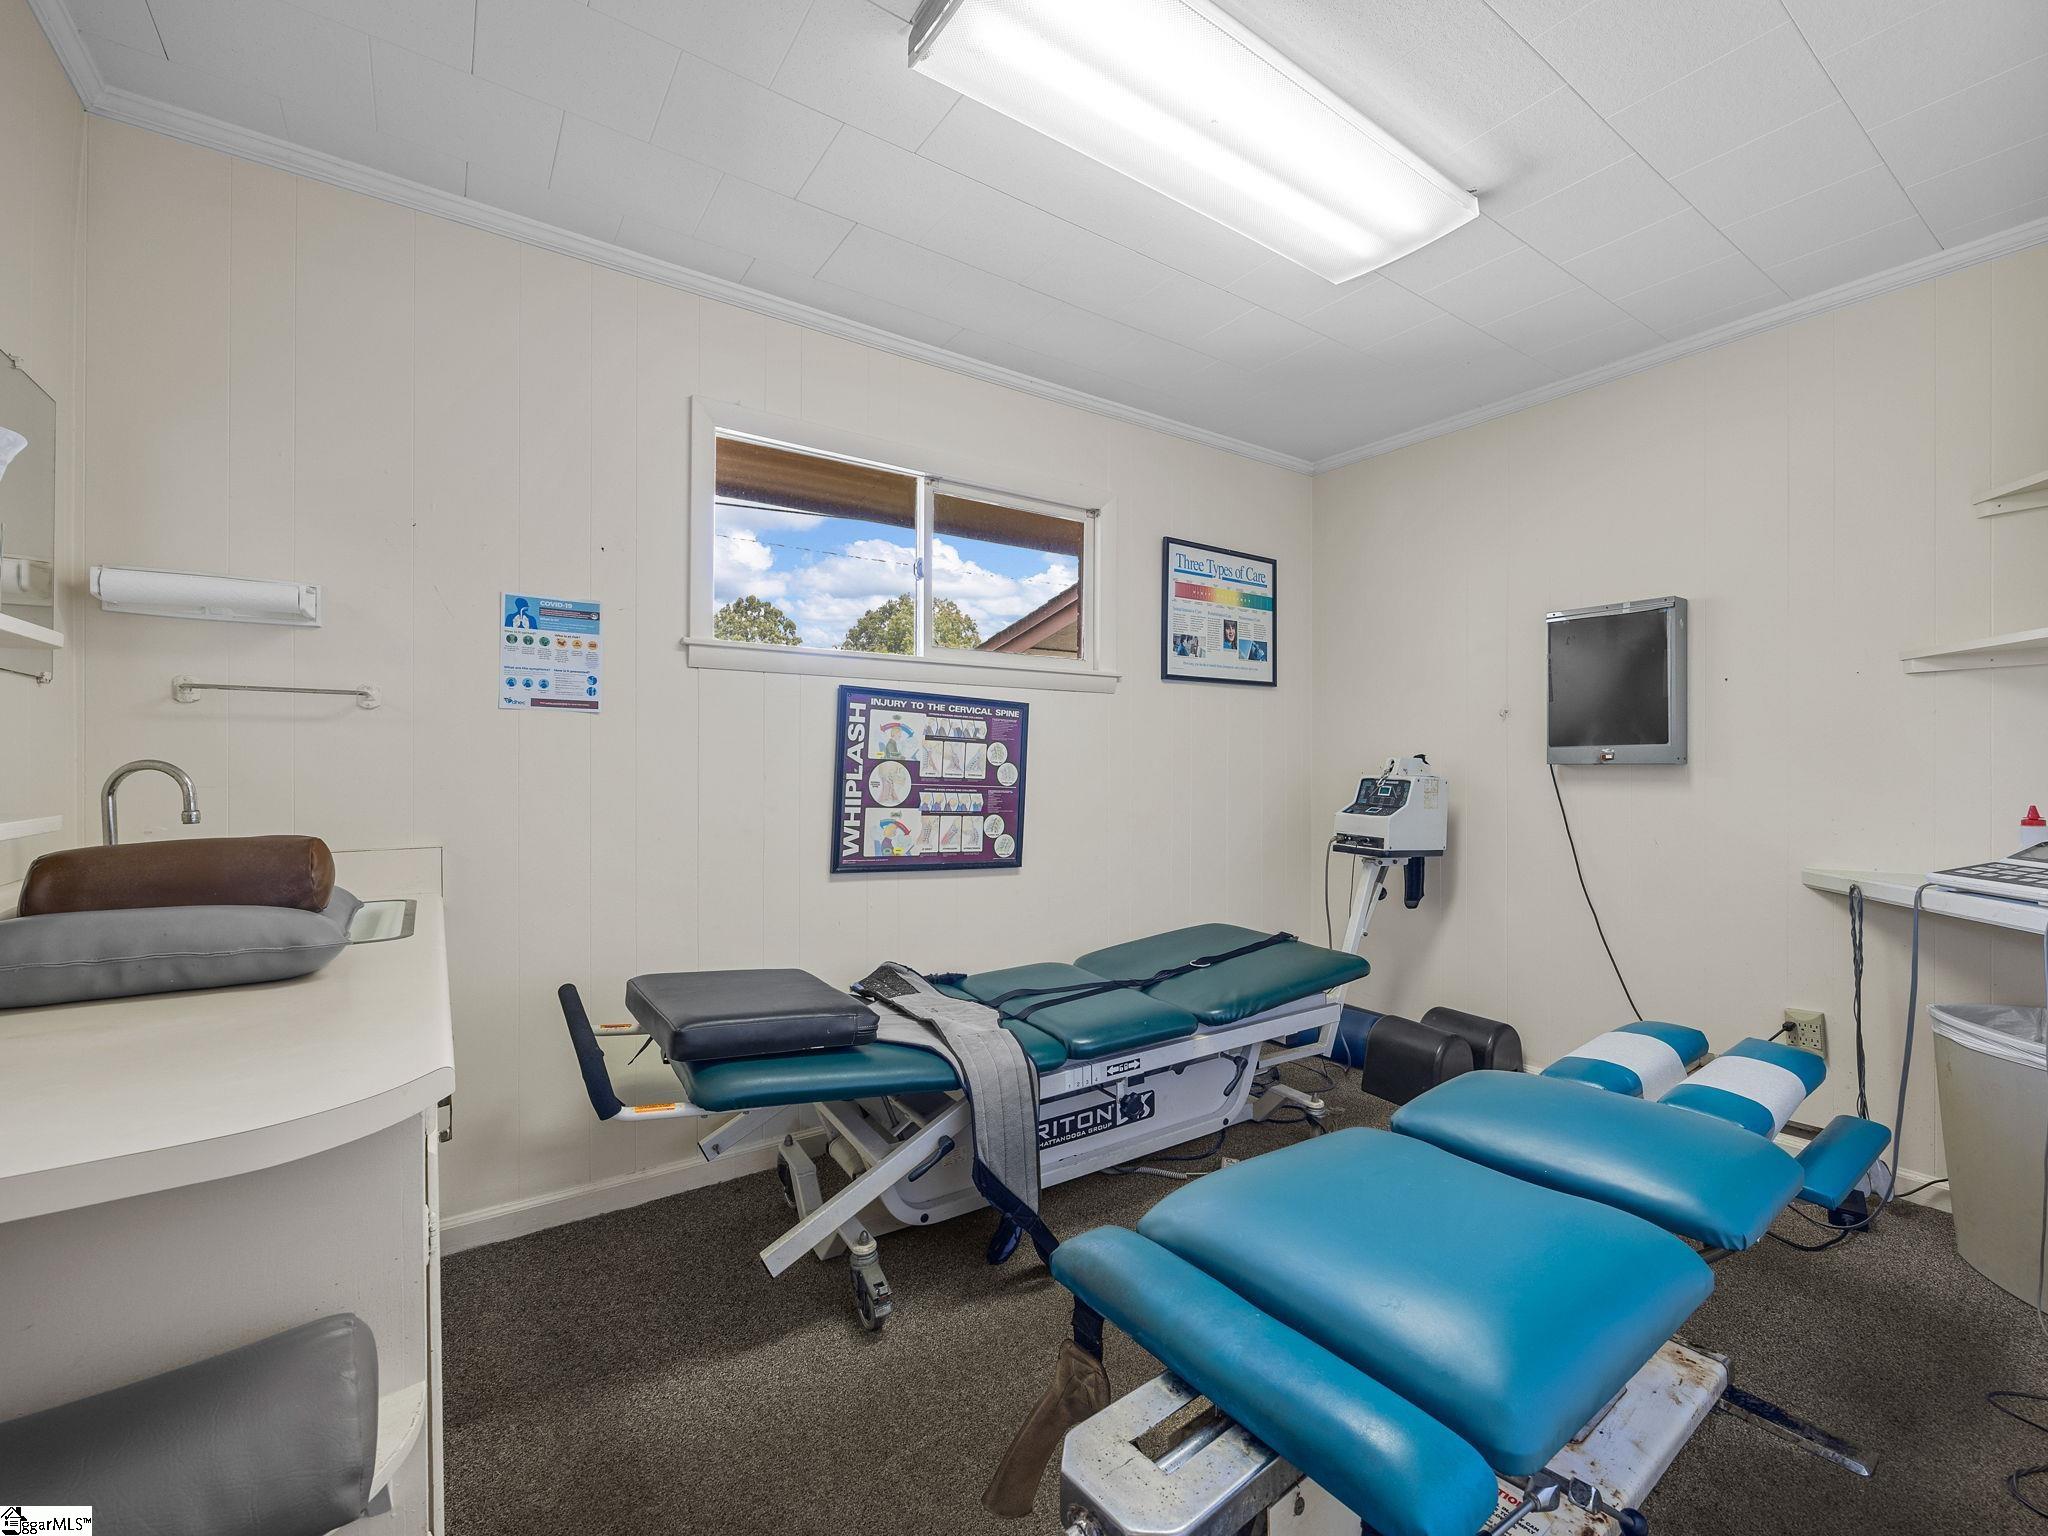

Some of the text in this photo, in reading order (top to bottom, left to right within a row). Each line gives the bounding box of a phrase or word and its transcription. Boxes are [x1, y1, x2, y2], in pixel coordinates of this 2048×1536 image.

[1176, 553, 1266, 583] Three Types of Care
[539, 600, 573, 609] COVID-19
[870, 698, 1020, 718] INJURY TO THE CERVICAL SPINE
[842, 702, 867, 857] WHIPLASH
[1039, 1105, 1112, 1139] RITON
[1040, 1122, 1113, 1148] HATTANOOGA GROUP
[1525, 1521, 1540, 1532] CAN
